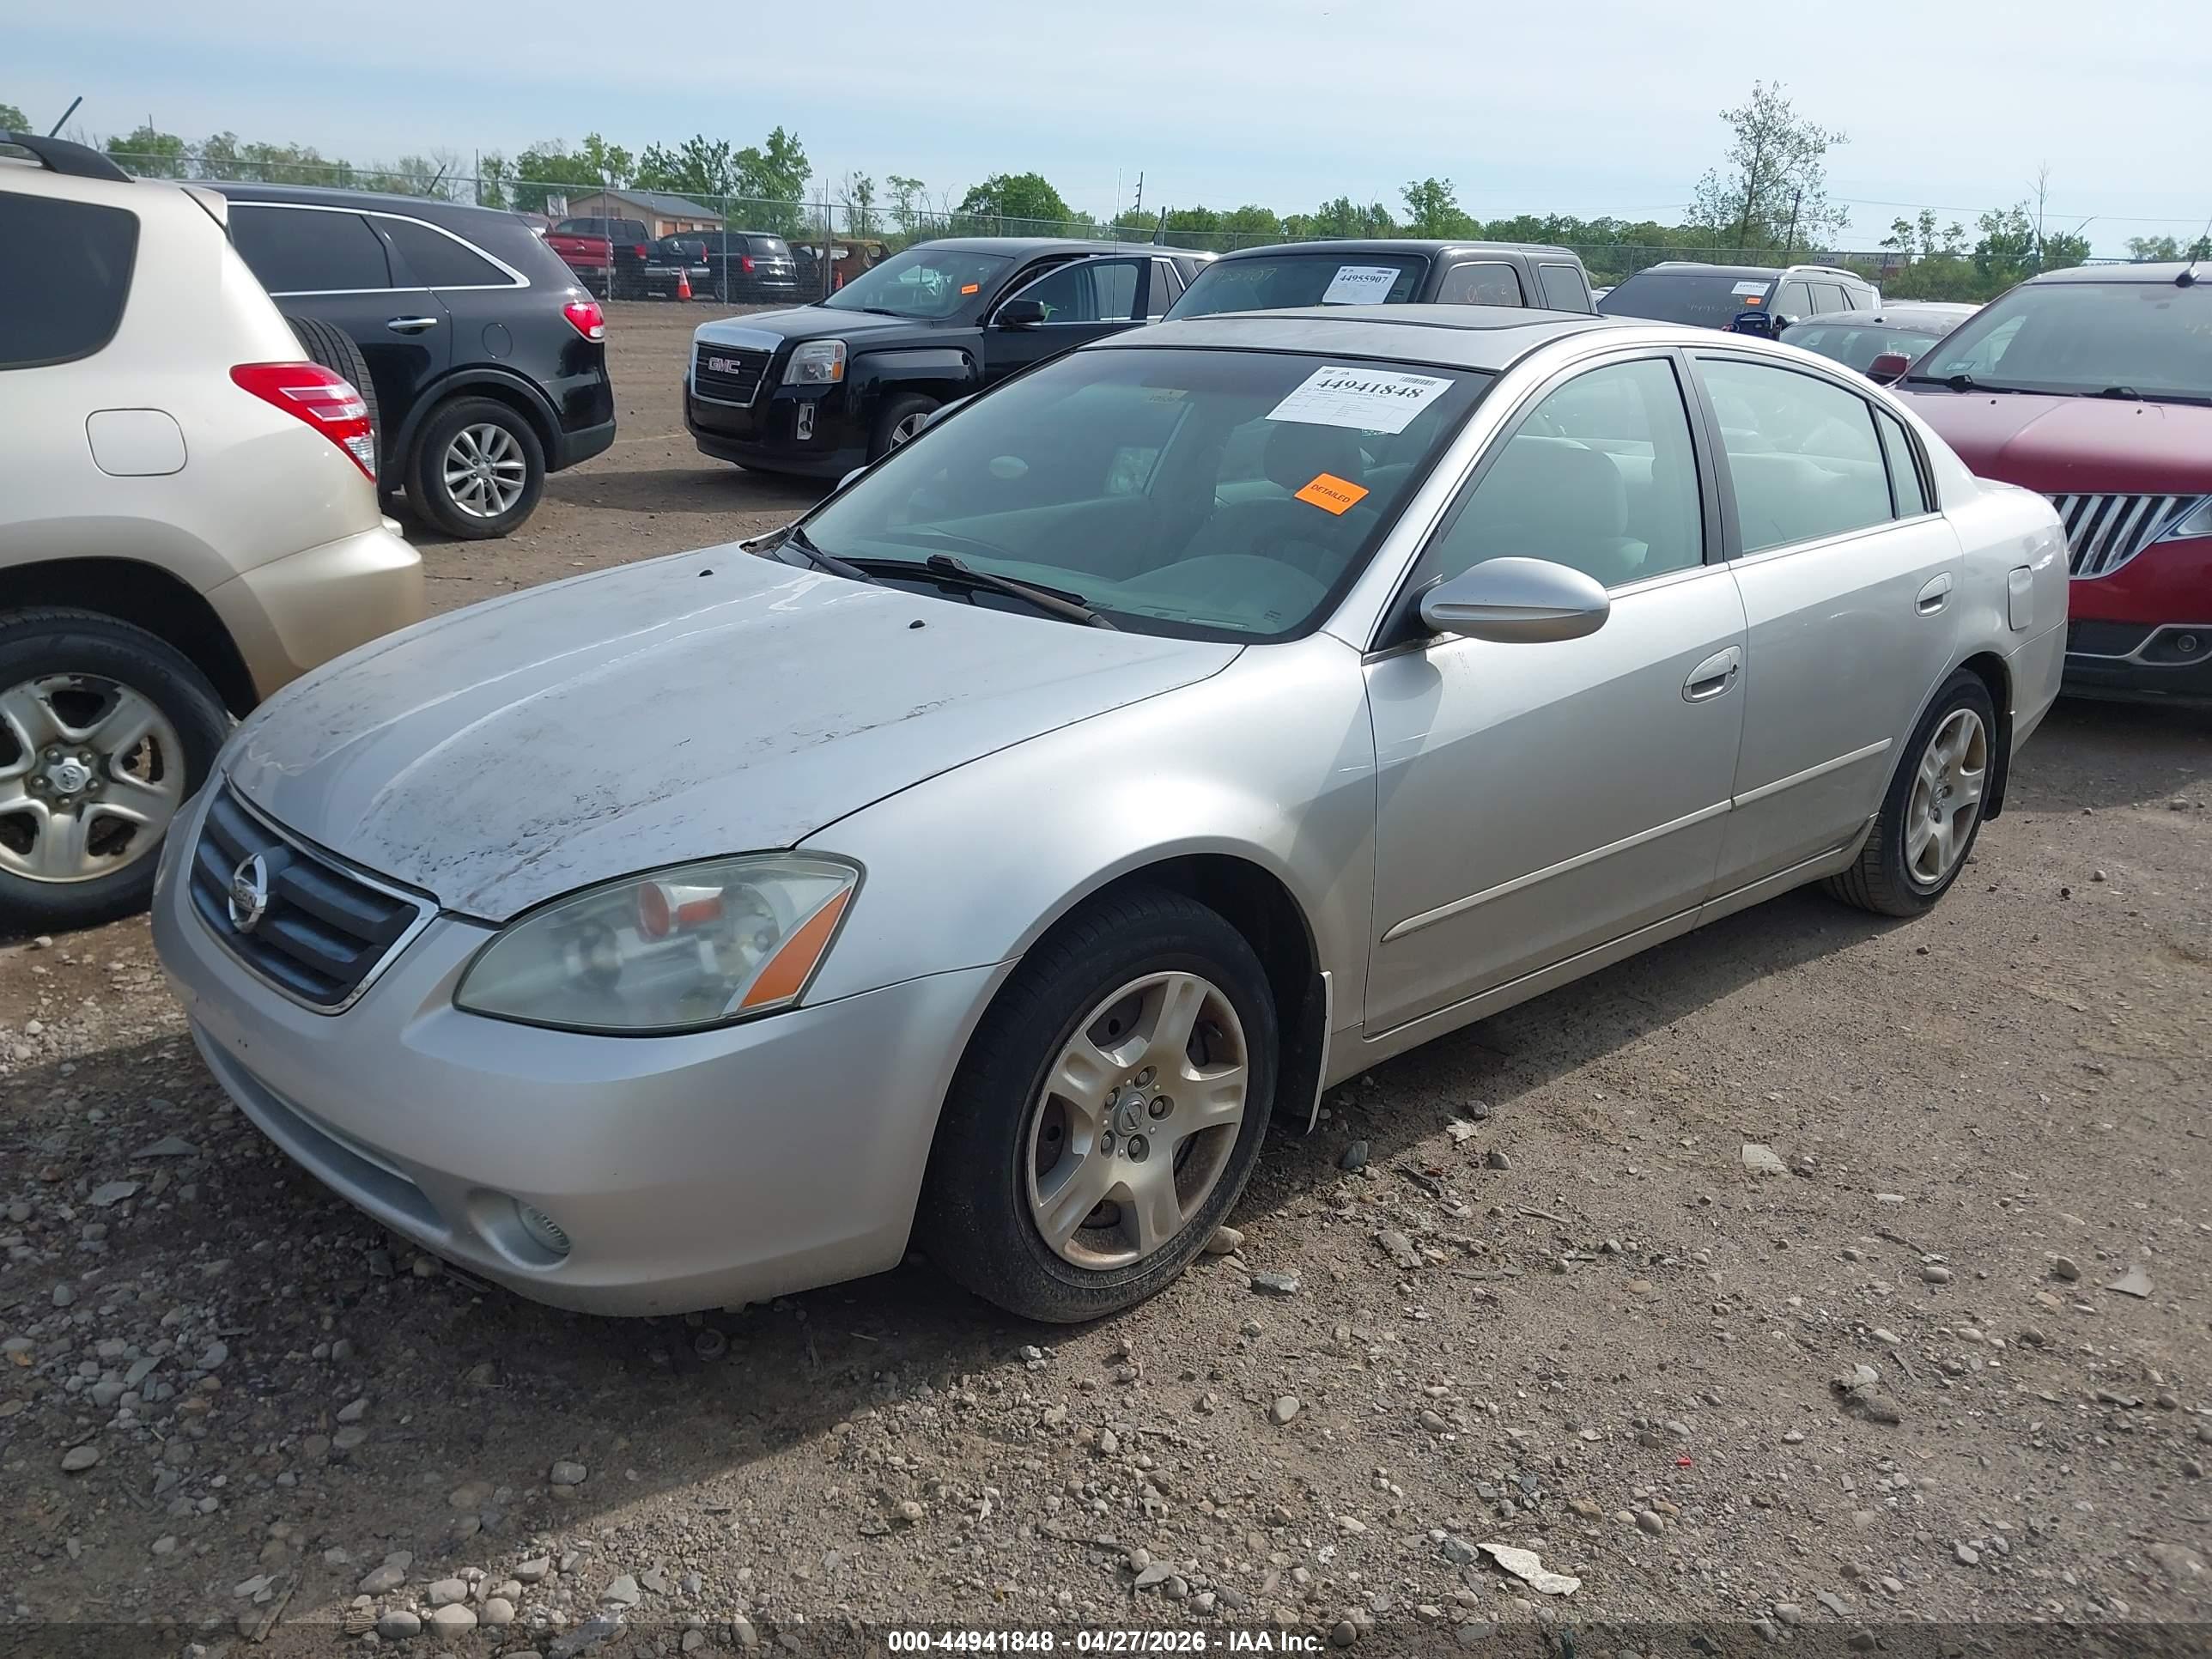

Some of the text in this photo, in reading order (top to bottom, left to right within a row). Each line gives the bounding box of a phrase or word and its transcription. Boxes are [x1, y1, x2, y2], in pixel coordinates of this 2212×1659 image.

[1340, 274, 1389, 283] 44955907
[708, 356, 740, 374] GMC
[1316, 378, 1425, 398] 44941848
[1310, 483, 1351, 503] DETAILED
